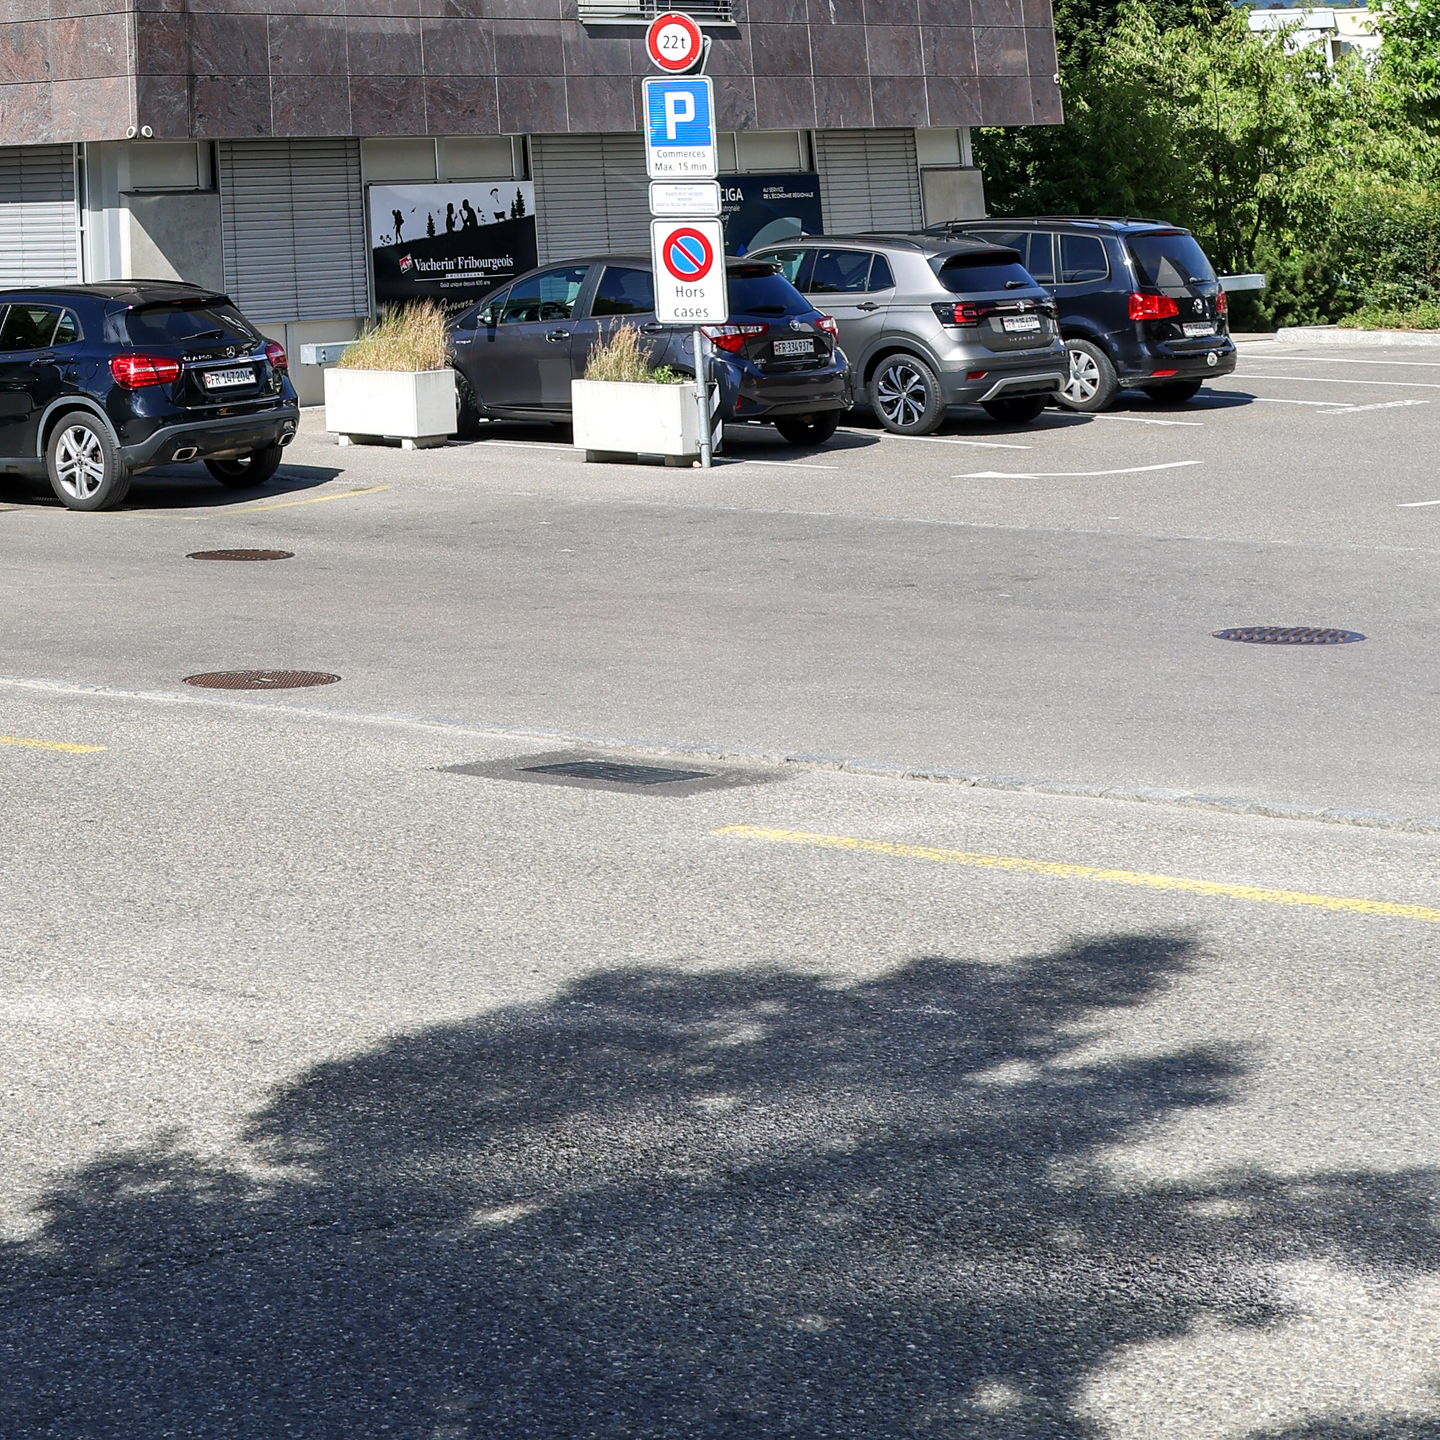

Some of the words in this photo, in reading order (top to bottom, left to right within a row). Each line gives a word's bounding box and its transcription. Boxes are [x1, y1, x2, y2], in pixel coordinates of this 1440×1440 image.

[664, 91, 695, 140] P
[657, 149, 706, 158] Commerces
[655, 162, 676, 171] Max.
[679, 162, 688, 171] 15
[690, 162, 710, 171] min.
[458, 254, 514, 271] Fribourgeois
[675, 286, 705, 298] Hors
[674, 307, 709, 318] cases
